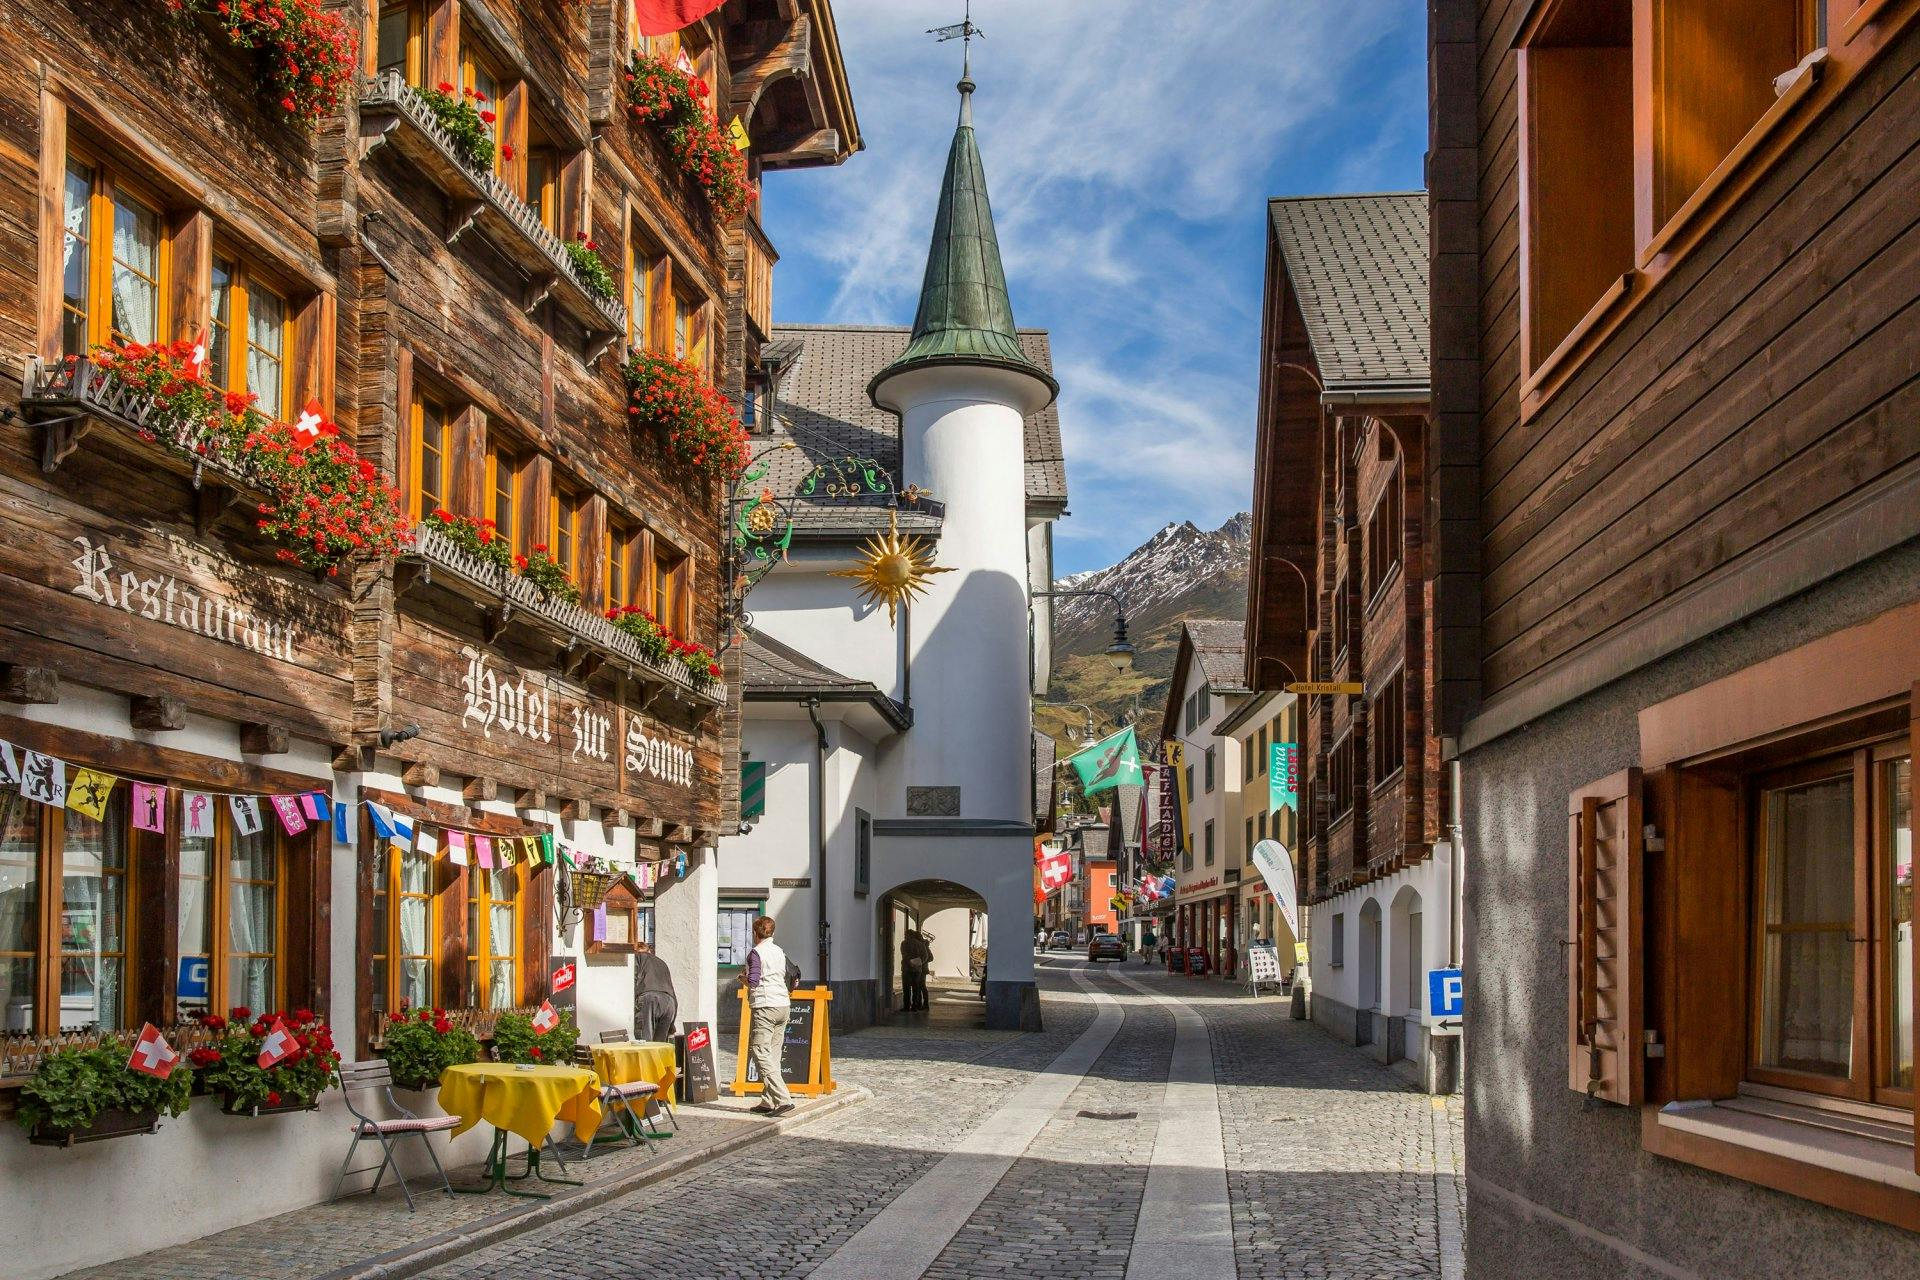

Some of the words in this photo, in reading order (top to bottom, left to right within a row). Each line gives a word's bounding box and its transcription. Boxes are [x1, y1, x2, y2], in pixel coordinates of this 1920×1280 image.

[72, 536, 296, 663] Restaurant
[461, 646, 552, 744] Hotel
[572, 706, 610, 764] zur
[626, 714, 694, 788] Sonne
[1272, 746, 1287, 797] Alpina
[1287, 747, 1298, 793] SPORT
[555, 968, 573, 987] rivella
[1443, 976, 1463, 1011] P
[691, 1031, 707, 1047] rivella
